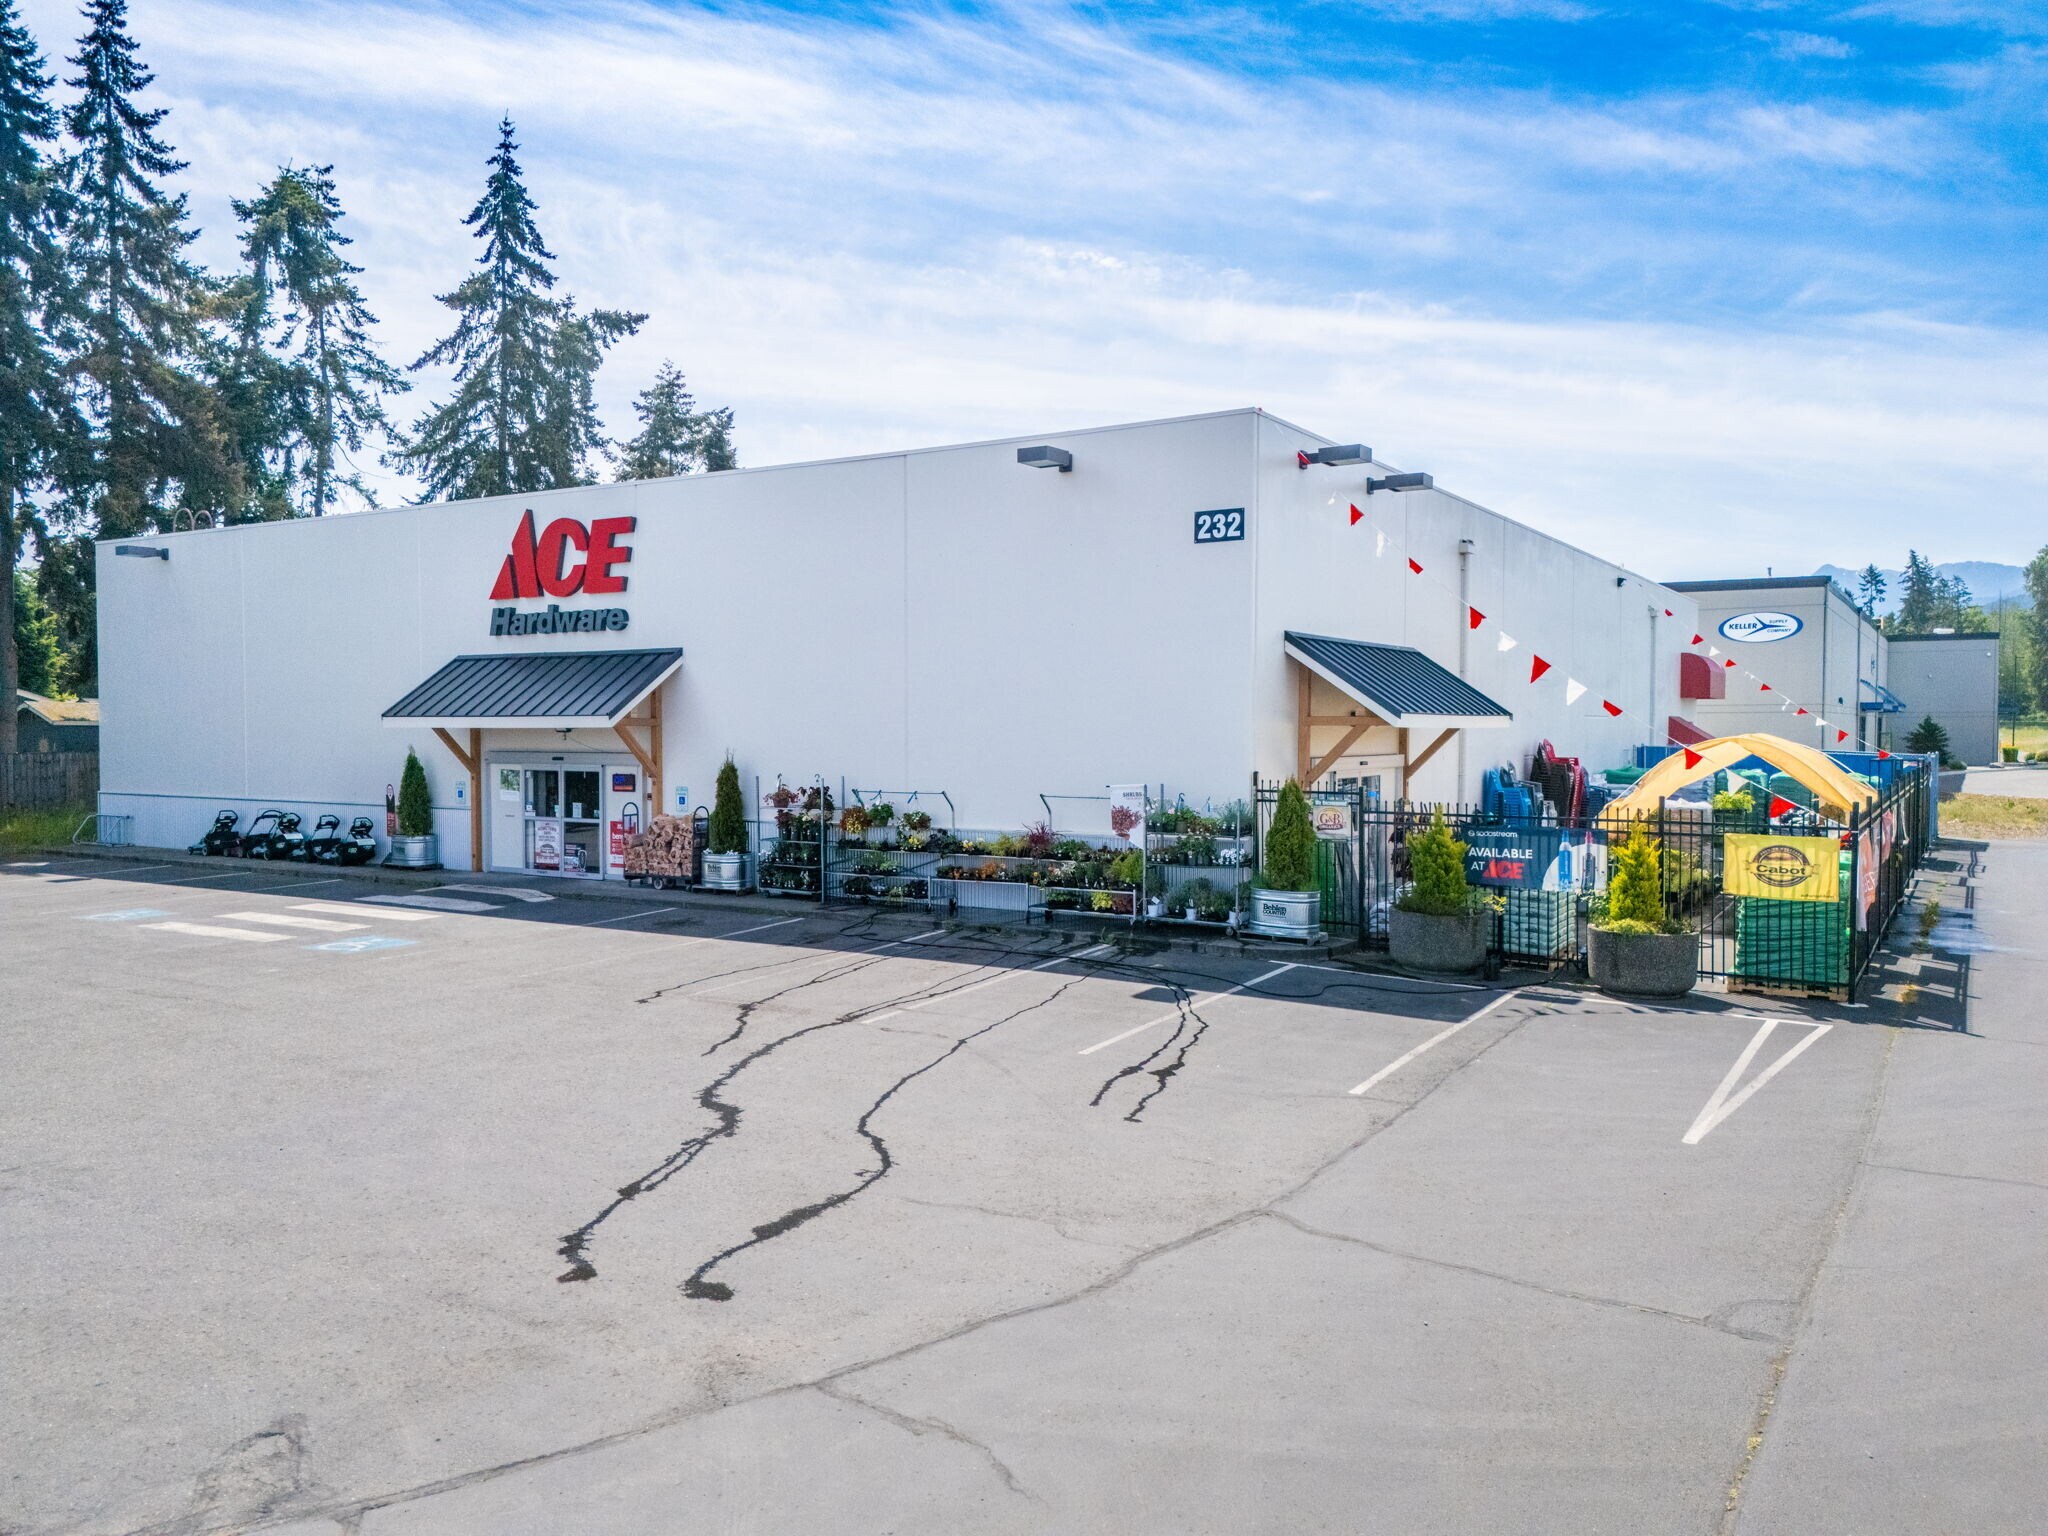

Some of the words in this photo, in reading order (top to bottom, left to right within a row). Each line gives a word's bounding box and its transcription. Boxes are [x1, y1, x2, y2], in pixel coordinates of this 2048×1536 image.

[1198, 512, 1240, 539] 232
[489, 509, 637, 599] ACE
[490, 604, 629, 636] Hardware
[1476, 829, 1518, 838] sodastream
[1468, 847, 1533, 859] AVAILABLE
[1471, 861, 1485, 871] AT
[1482, 860, 1525, 879] ACE
[1756, 864, 1806, 875] Cabot
[1263, 903, 1287, 912] Behlen
